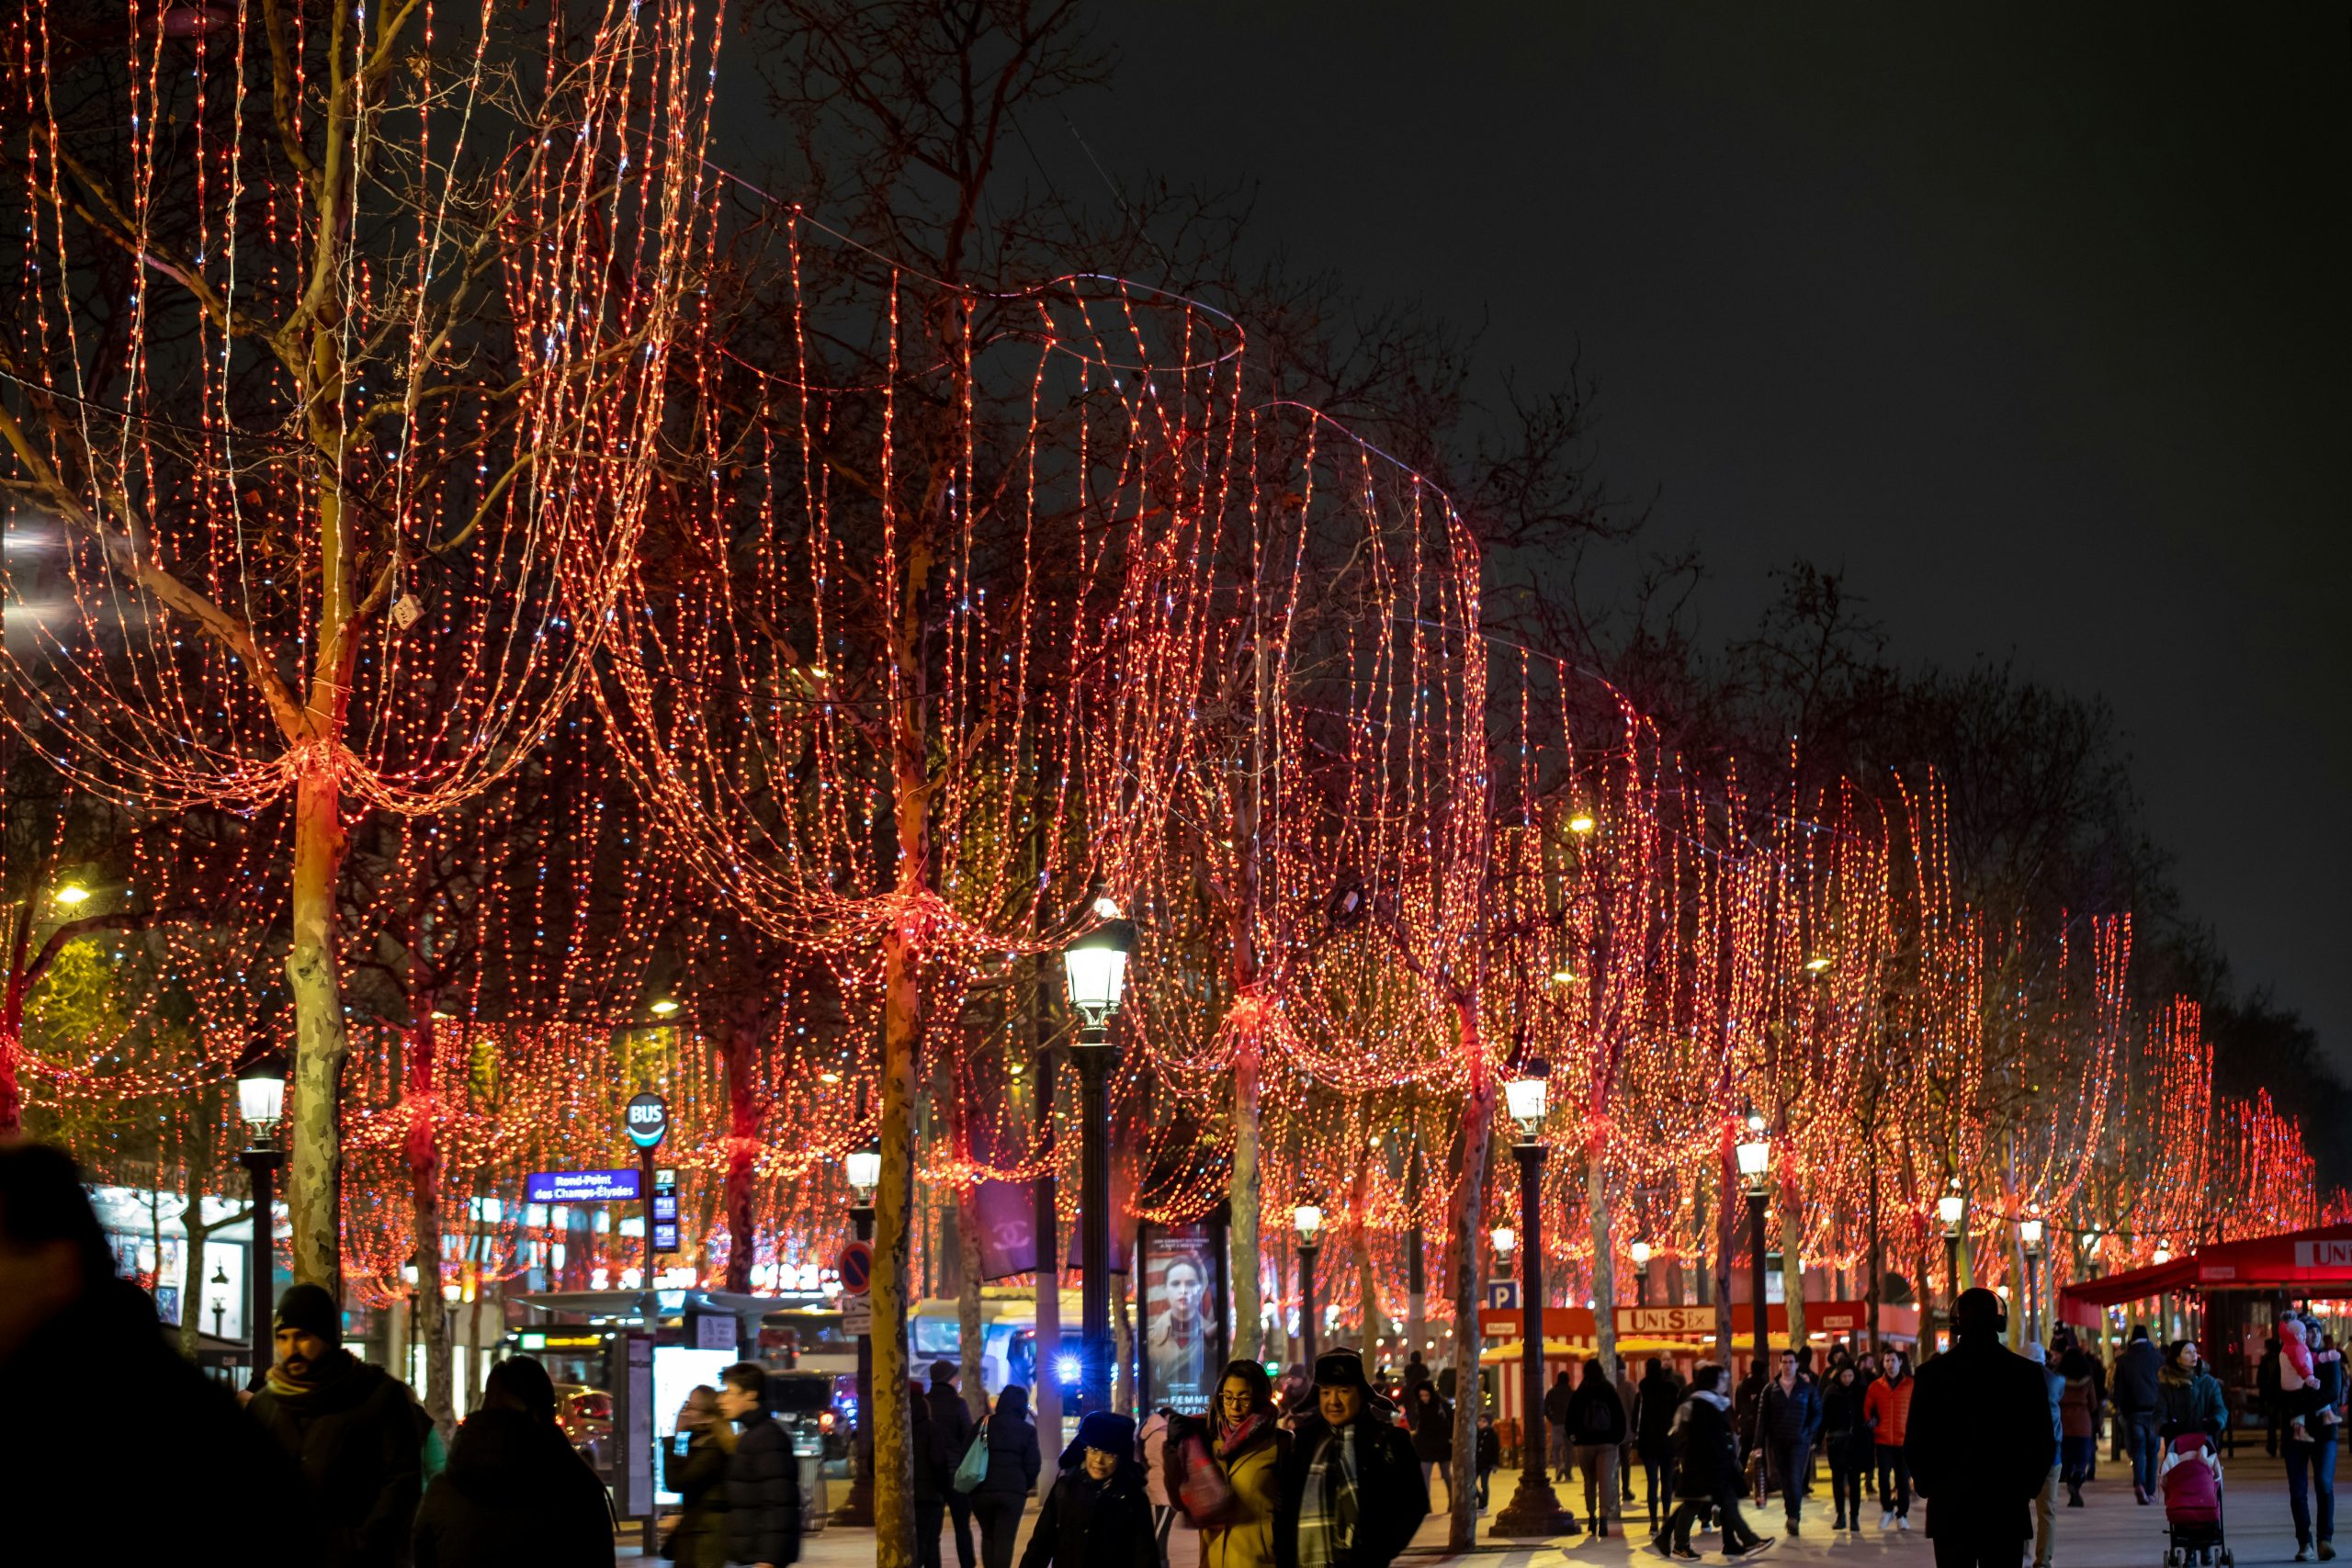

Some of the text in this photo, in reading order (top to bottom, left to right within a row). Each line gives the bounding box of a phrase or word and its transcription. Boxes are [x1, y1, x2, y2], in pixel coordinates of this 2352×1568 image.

[629, 1104, 662, 1123] BUS
[555, 1175, 612, 1186] Rond-Point
[657, 1170, 674, 1183] 73
[535, 1185, 634, 1200] des Champs-Élysées
[1495, 1287, 1510, 1308] P
[1170, 1395, 1210, 1404] FEMME
